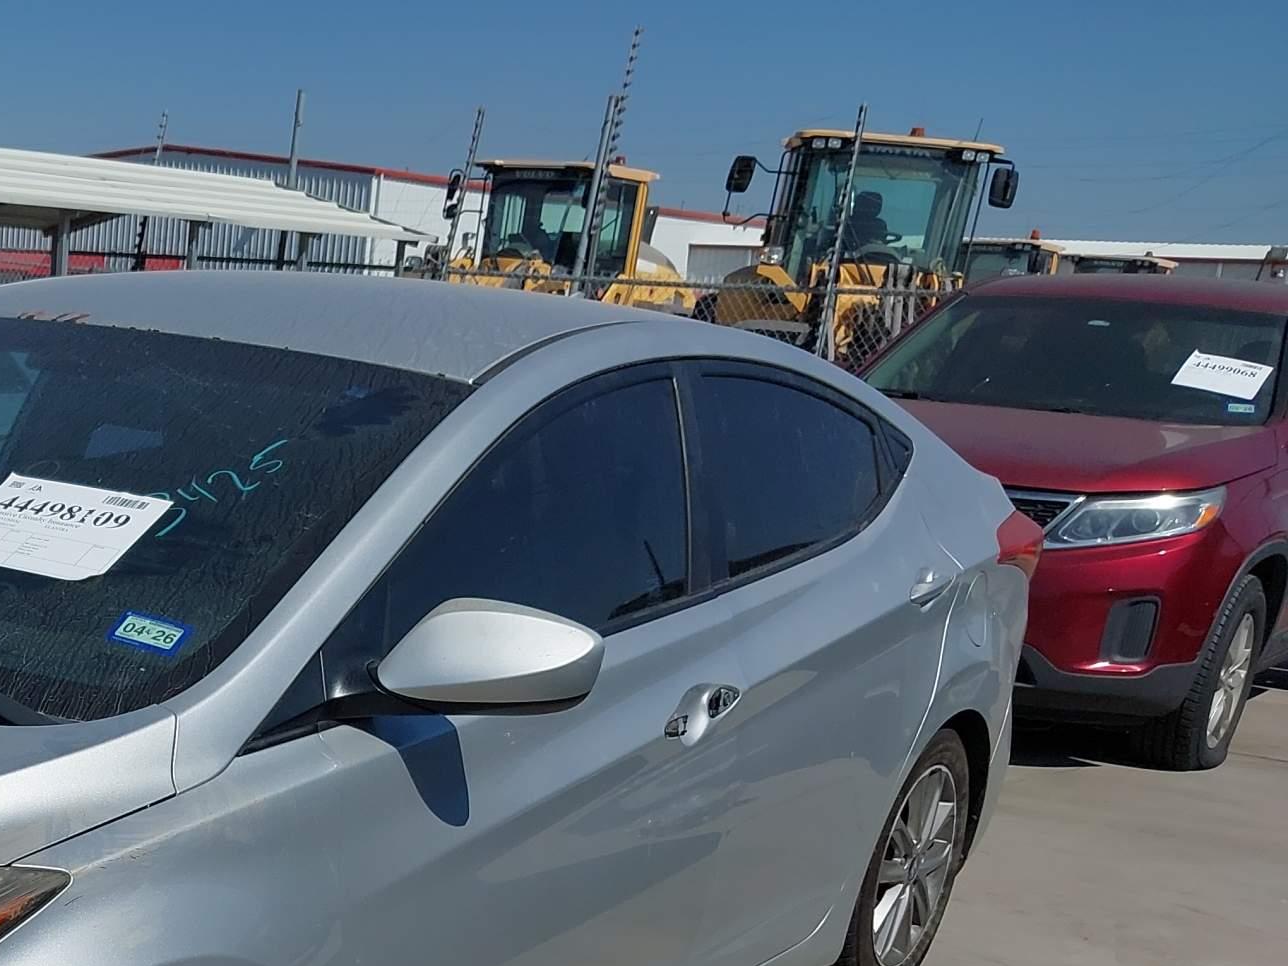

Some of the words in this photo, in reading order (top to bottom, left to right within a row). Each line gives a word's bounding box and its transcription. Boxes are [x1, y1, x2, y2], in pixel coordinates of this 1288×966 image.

[1192, 360, 1258, 378] 44499068
[122, 622, 147, 637] 04
[150, 630, 177, 645] 26
